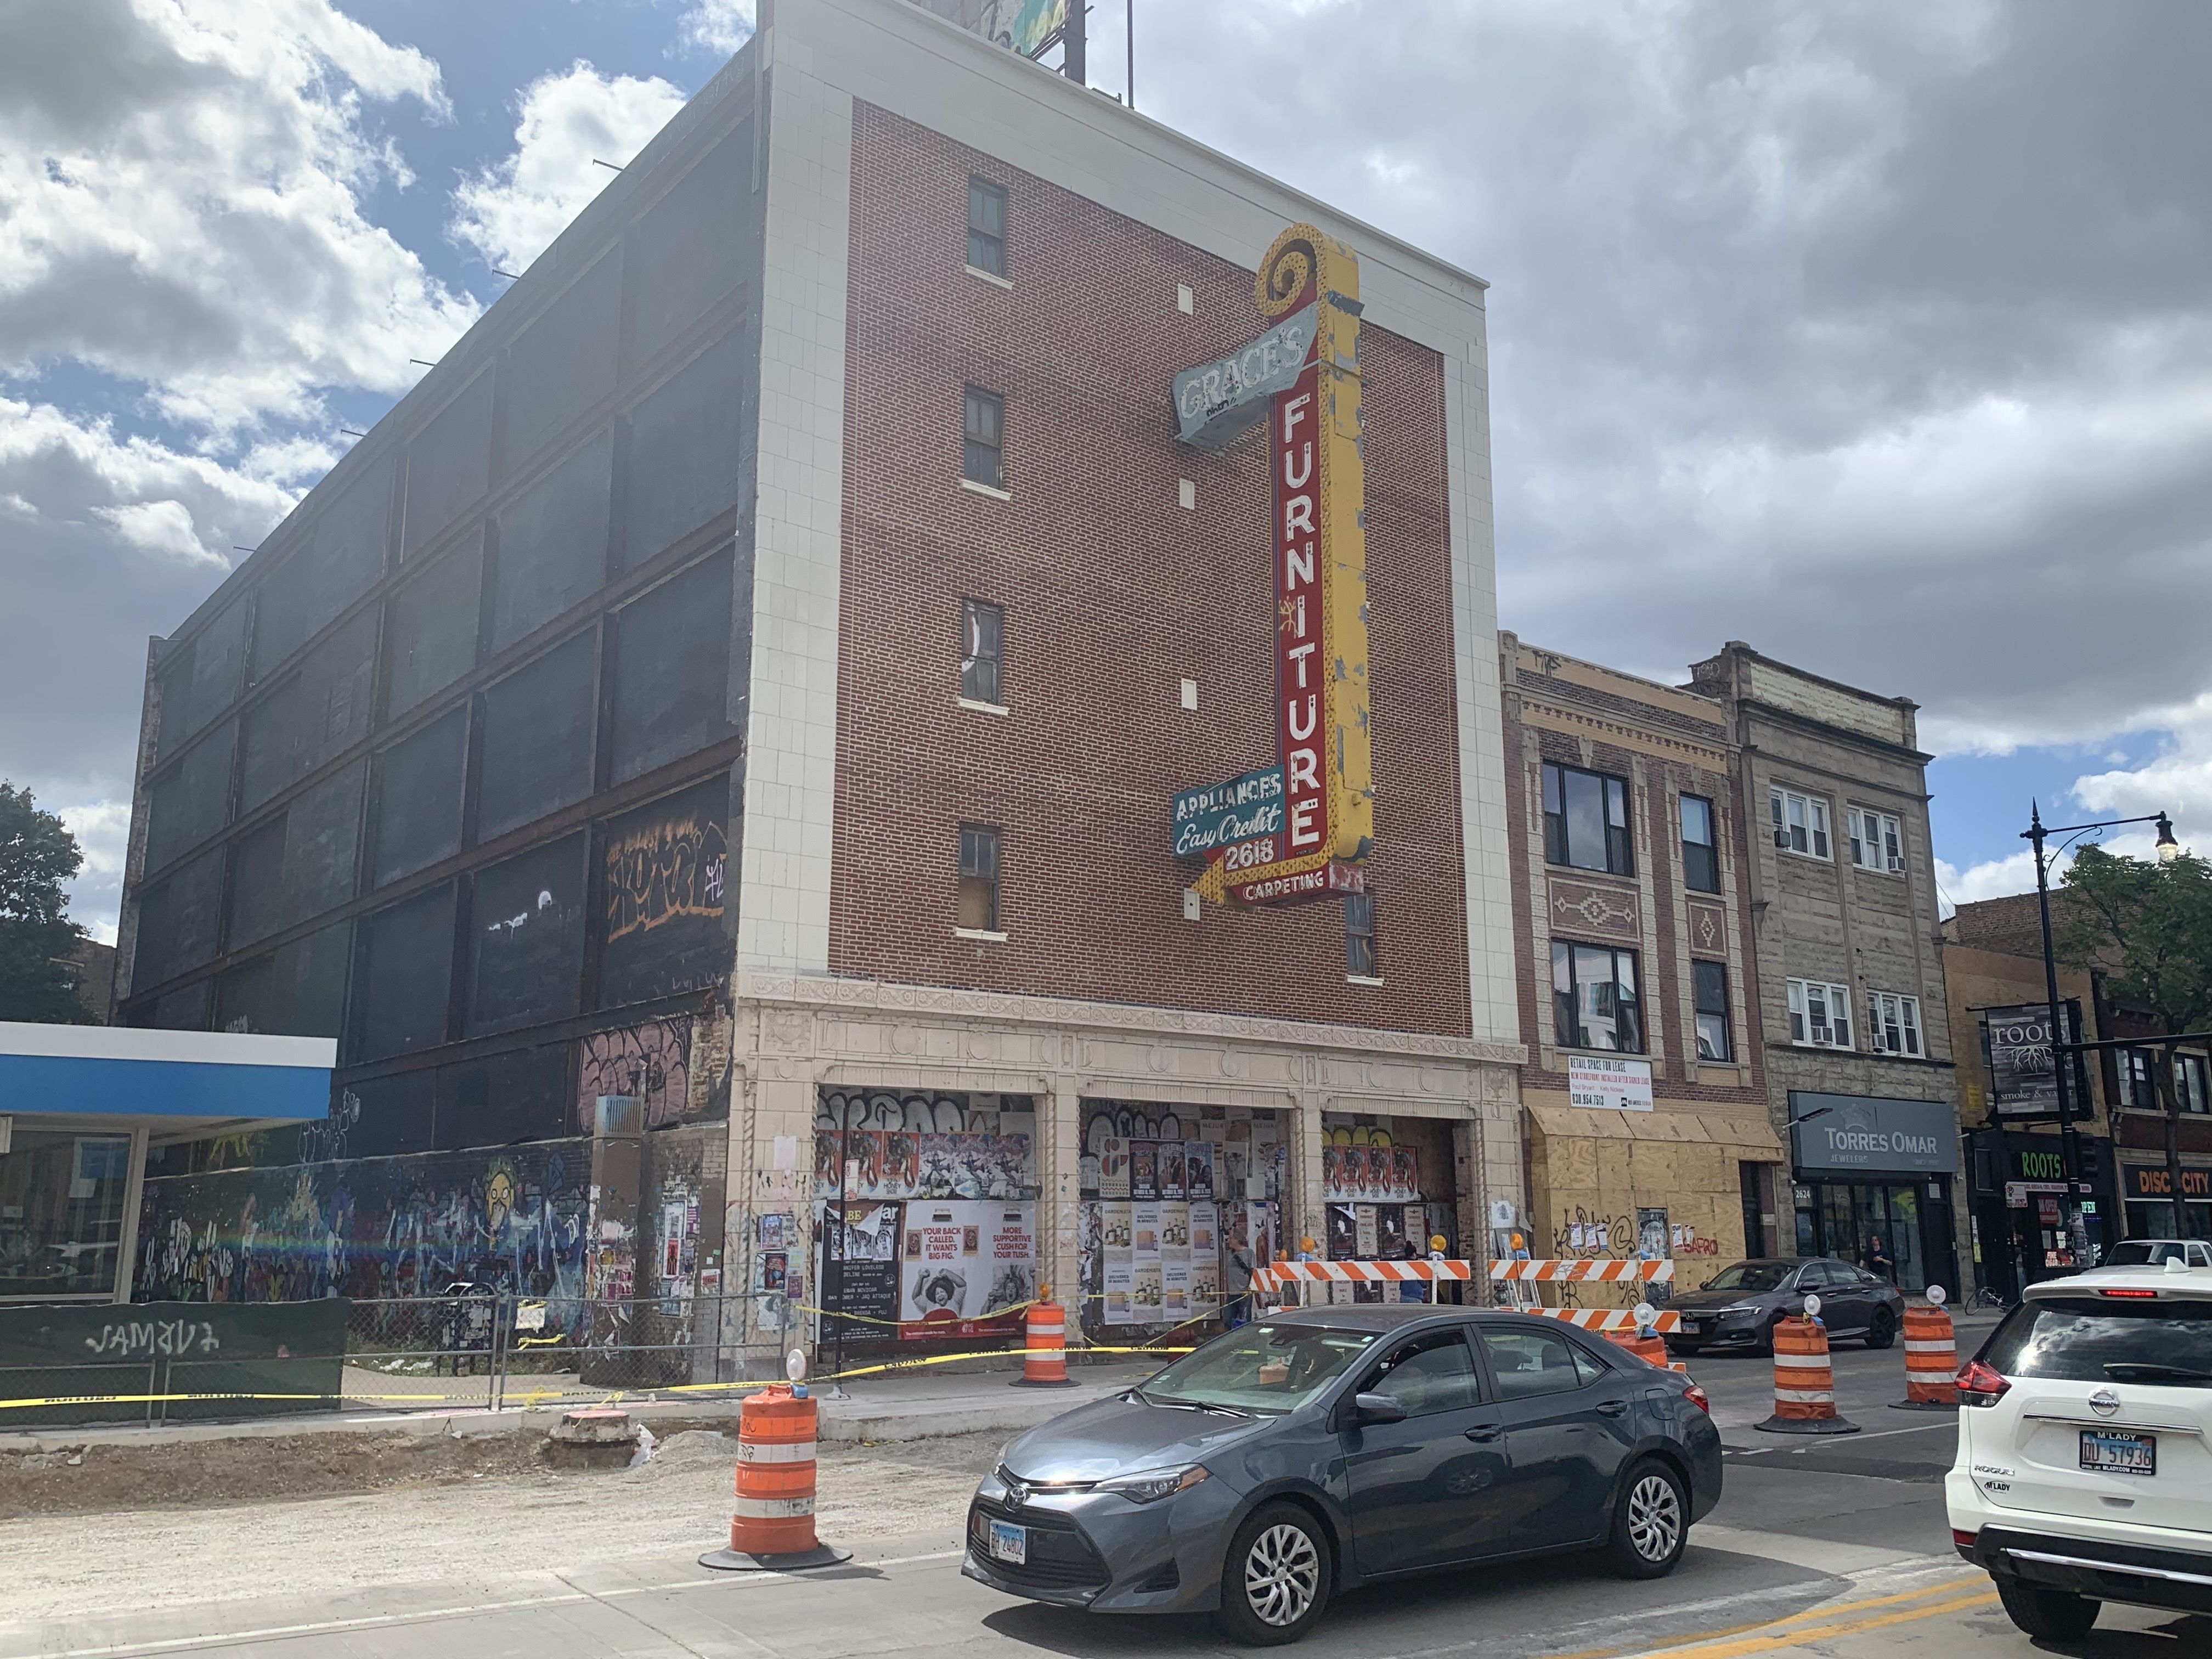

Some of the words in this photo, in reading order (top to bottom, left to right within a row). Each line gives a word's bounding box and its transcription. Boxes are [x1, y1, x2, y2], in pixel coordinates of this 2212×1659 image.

[1180, 326, 1304, 419] GRACE'S
[1283, 391, 1319, 847] FURNITURE
[1176, 772, 1282, 822] APPLIANCES
[1176, 823, 1216, 855] Easy
[1217, 803, 1282, 842] Credit
[1224, 838, 1274, 871] 2618
[1243, 871, 1324, 901] CARPETING
[1570, 1058, 1586, 1069] RETAIL
[1587, 1059, 1601, 1070] SPACE
[1602, 1060, 1611, 1071] FOR
[1612, 1062, 1626, 1073] LEASE
[1579, 1073, 1599, 1081] STOREFRONT
[1600, 1074, 1617, 1083] INSTALLED
[1618, 1075, 1628, 1084] AFTER
[1628, 1076, 1640, 1085] SIGNED
[1640, 1077, 1650, 1085] LEASE
[1581, 1084, 1595, 1092] Bryant
[2001, 1090, 2030, 1099] smoke
[2047, 1088, 2073, 1098] var
[1572, 1093, 1604, 1106] 630.954.7513
[1830, 1154, 1869, 1164] JEWELERS
[2022, 1152, 2061, 1178] ROOTS
[2139, 1170, 2171, 1194] DISC
[2181, 1171, 2209, 1194] CITY
[1796, 1189, 1810, 1199] 2624
[2081, 1201, 2096, 1214] PEN
[847, 1210, 861, 1221] BE
[943, 1227, 961, 1235] BACK
[2097, 1431, 2136, 1442] M'LADY
[2083, 1442, 2100, 1462] DU
[2109, 1444, 2151, 1466] 57936
[1974, 1465, 2015, 1476] ROGUE
